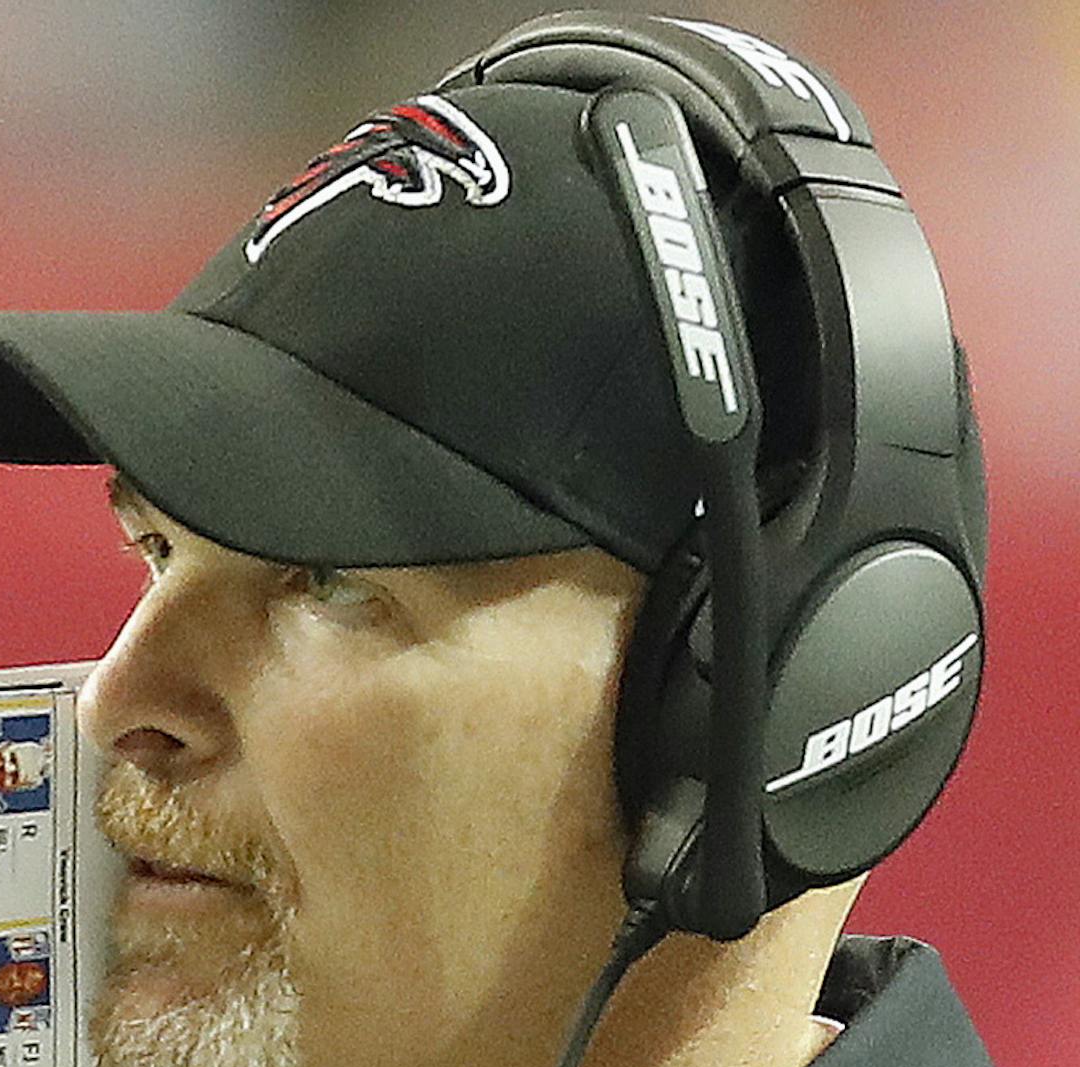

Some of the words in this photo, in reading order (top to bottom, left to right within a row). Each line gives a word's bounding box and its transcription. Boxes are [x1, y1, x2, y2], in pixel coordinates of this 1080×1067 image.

[615, 121, 738, 413] BOSE
[765, 633, 978, 794] BOSE
[20, 824, 38, 840] R
[22, 1042, 40, 1063] FJ
